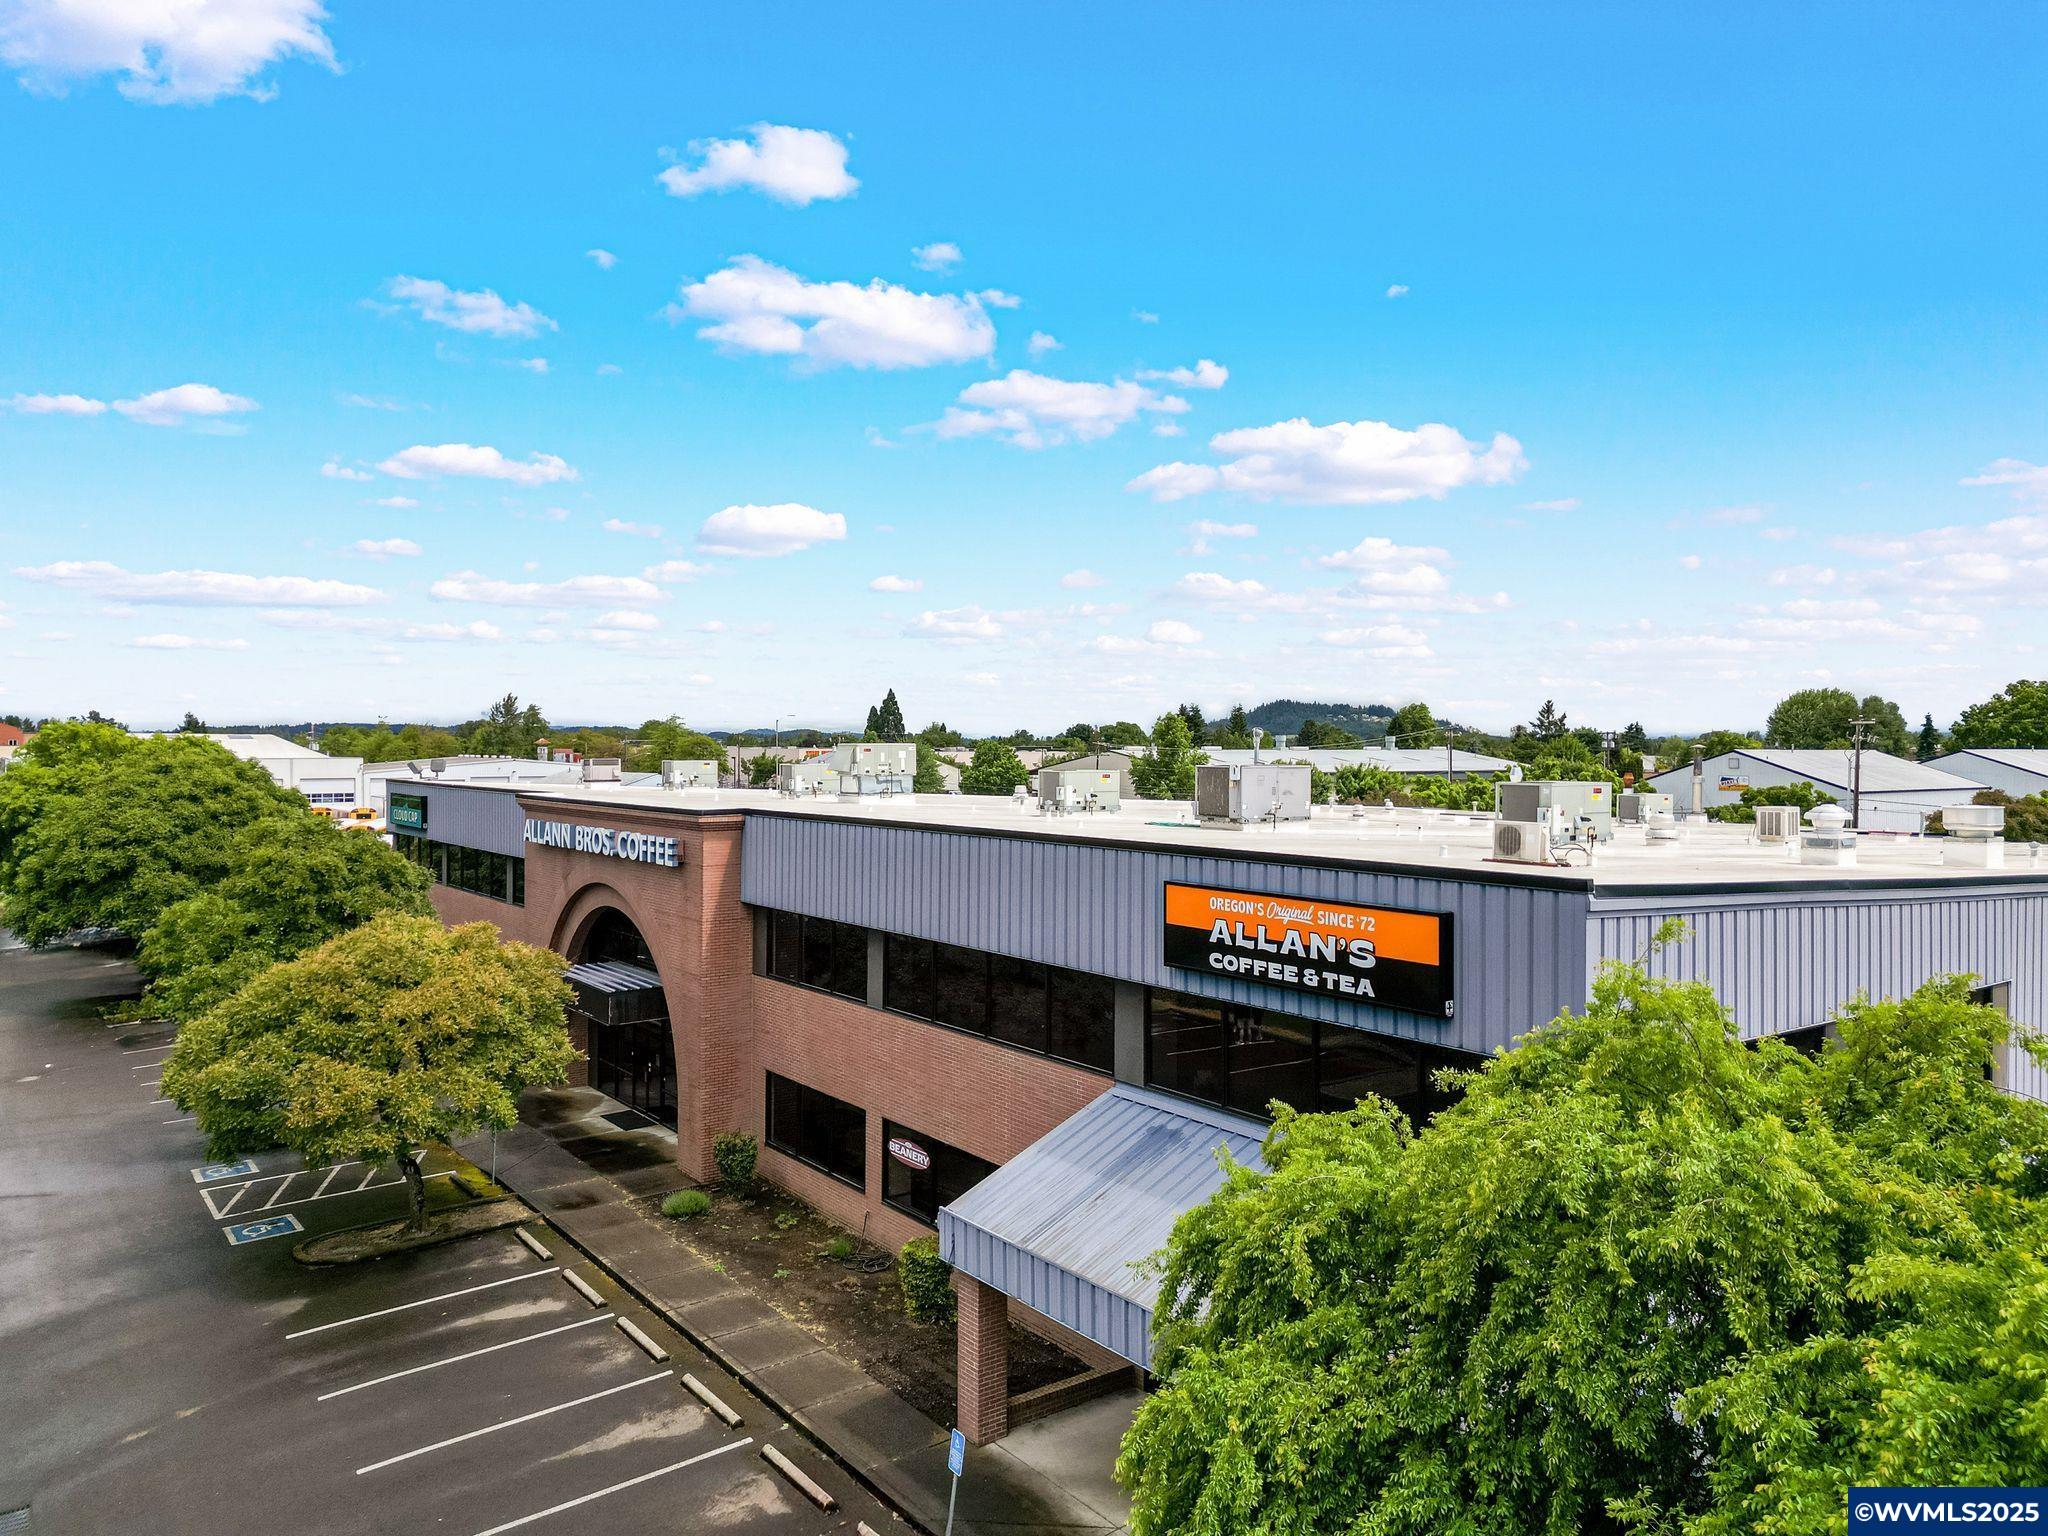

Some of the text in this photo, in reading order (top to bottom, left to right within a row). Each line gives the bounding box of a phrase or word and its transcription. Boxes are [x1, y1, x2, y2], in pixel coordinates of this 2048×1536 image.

[393, 808, 418, 823] CLOUD CAP
[523, 818, 678, 867] ALLANN BROS. COFFEE
[1209, 896, 1376, 932] OREGON'S Original SINCE '72
[1209, 918, 1377, 969] ALLAN'S
[1209, 952, 1376, 998] COFFEE & TEA
[888, 1140, 930, 1166] BEANERY
